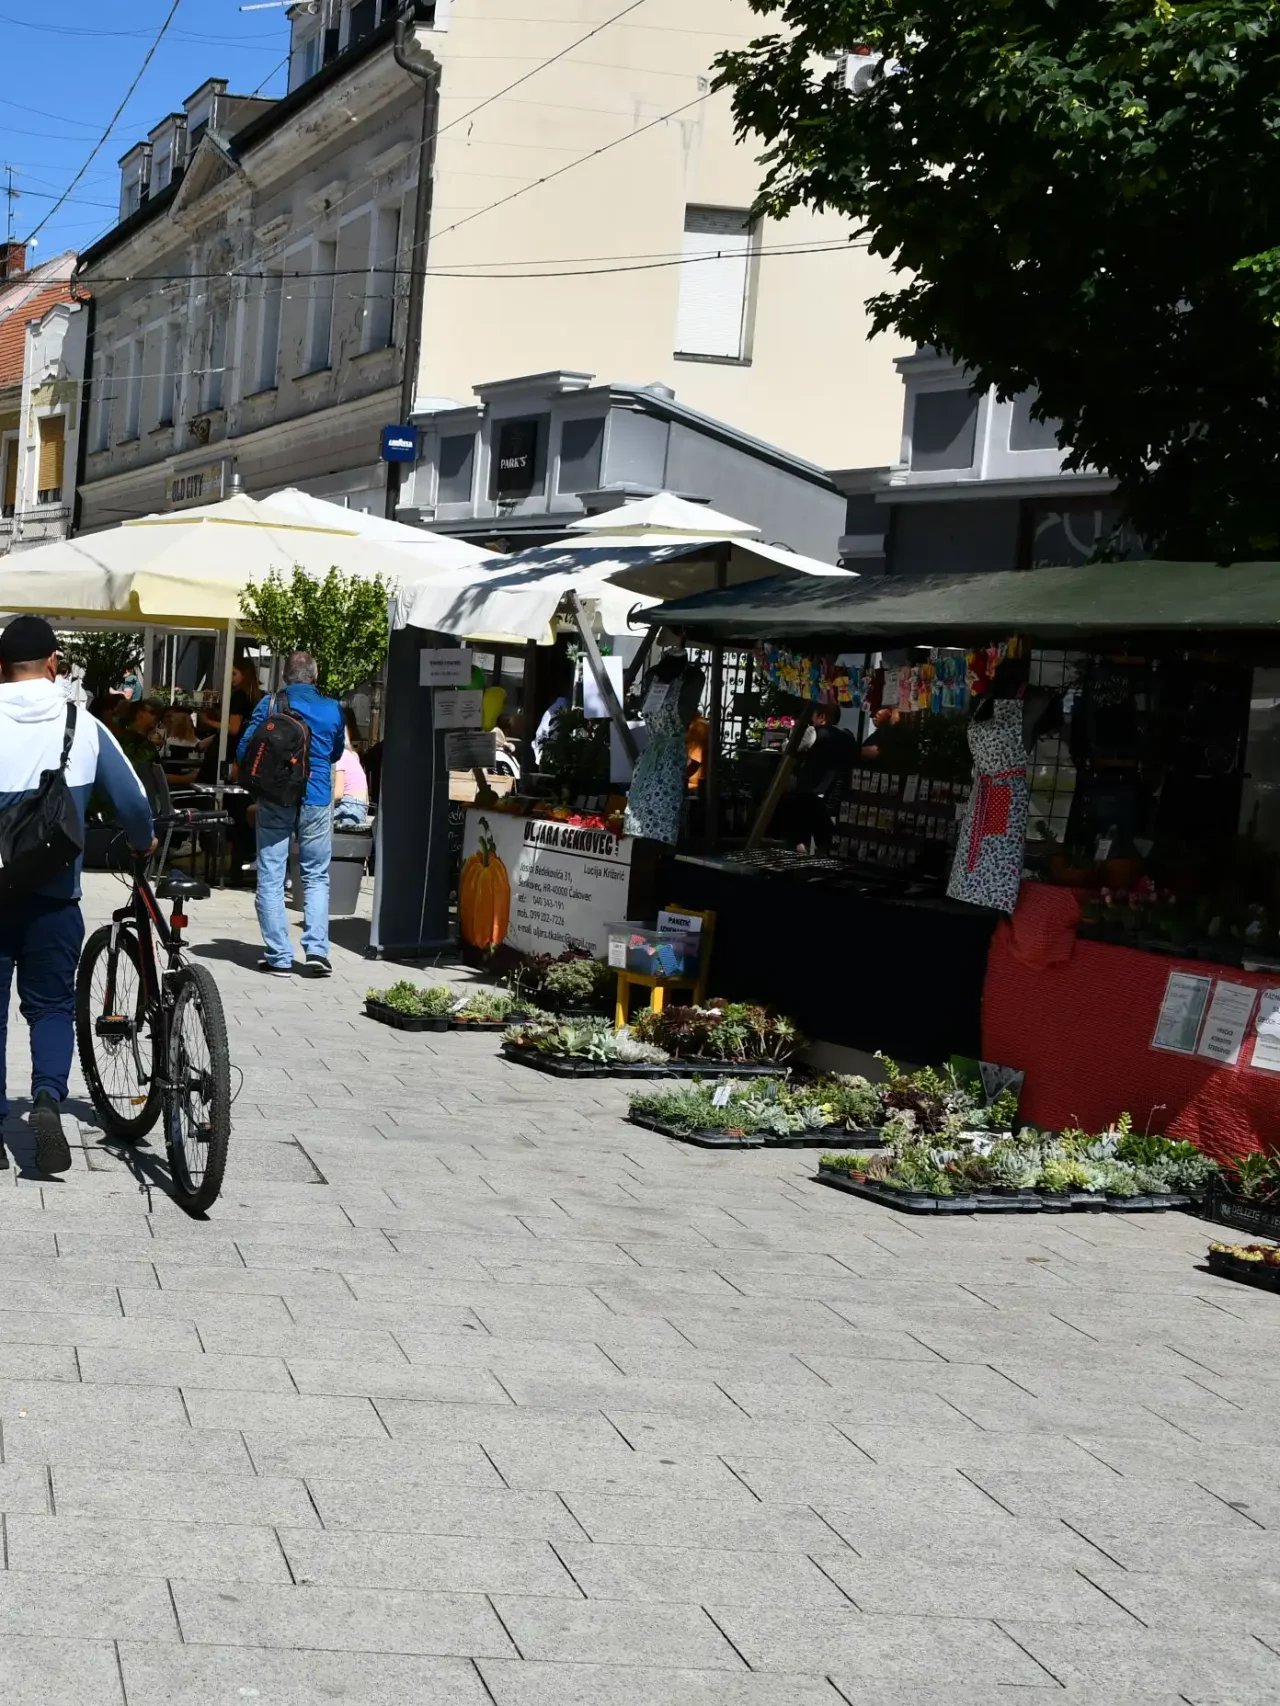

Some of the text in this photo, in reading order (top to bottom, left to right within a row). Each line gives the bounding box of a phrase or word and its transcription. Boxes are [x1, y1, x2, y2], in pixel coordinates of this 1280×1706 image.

[172, 478, 186, 502] OLD
[186, 473, 204, 499] CITY
[524, 821, 560, 847] ULJARA
[583, 864, 602, 878] Lucija
[568, 886, 592, 902] Čakovec
